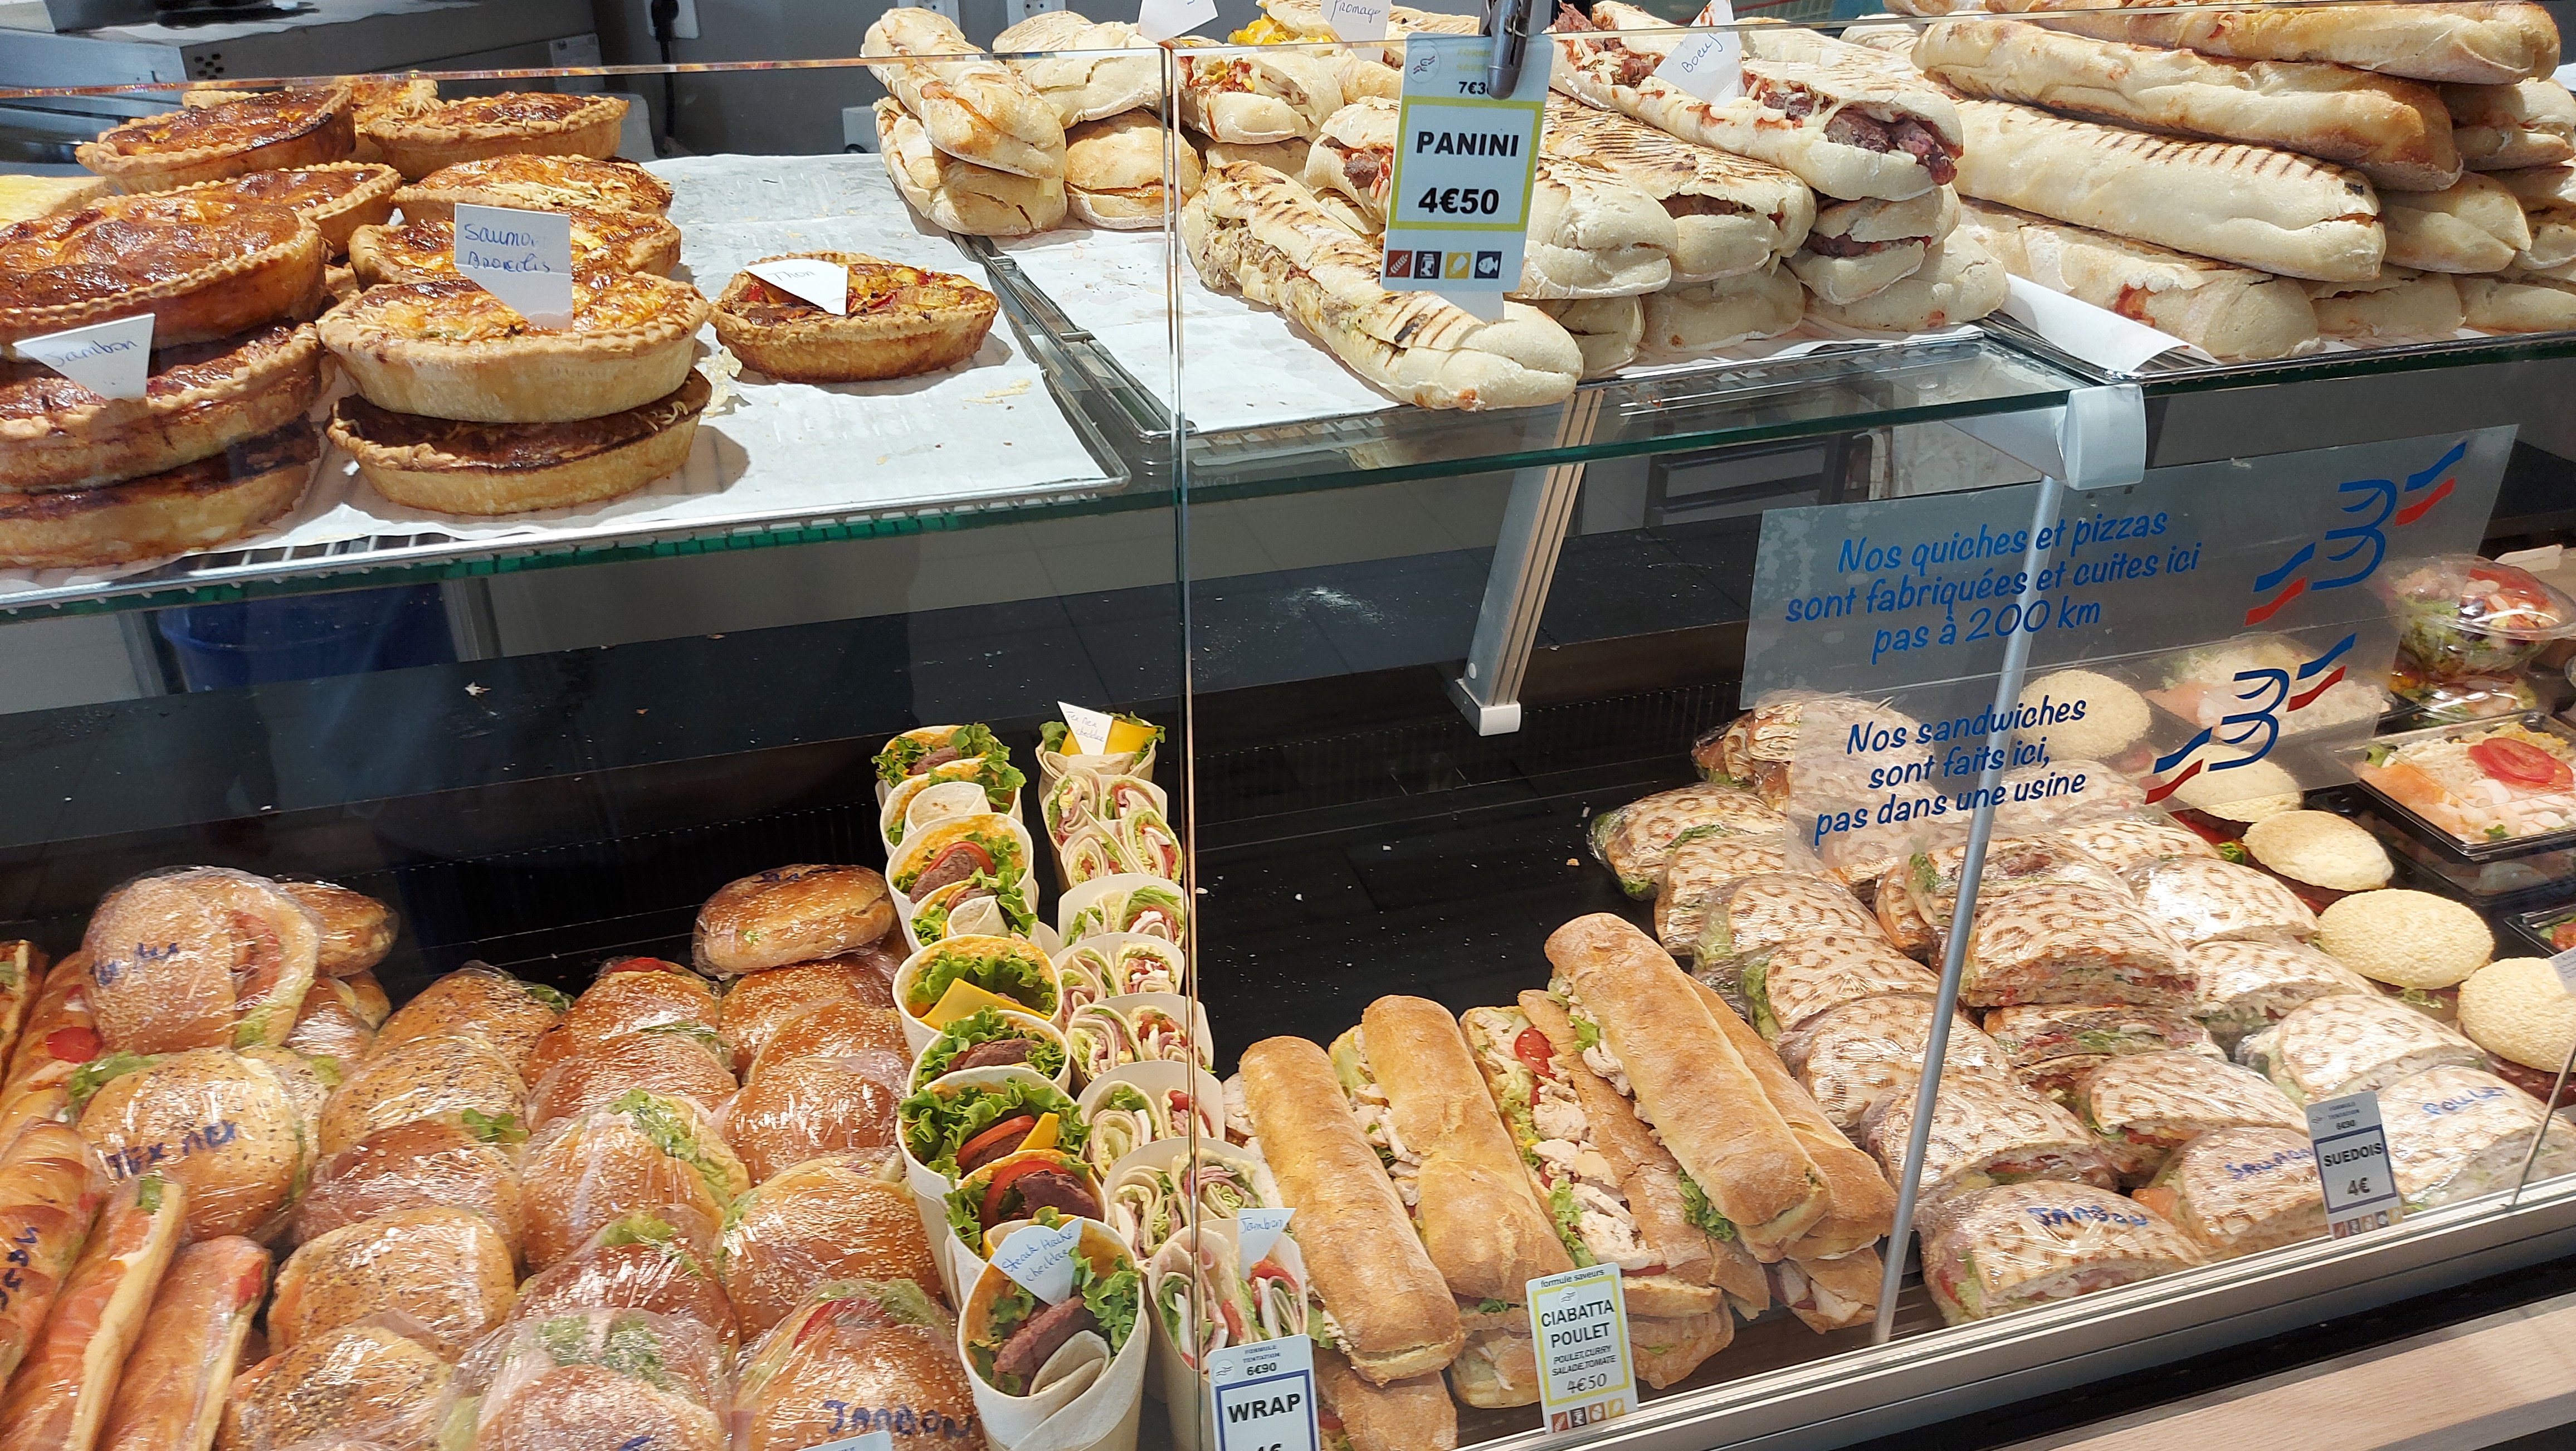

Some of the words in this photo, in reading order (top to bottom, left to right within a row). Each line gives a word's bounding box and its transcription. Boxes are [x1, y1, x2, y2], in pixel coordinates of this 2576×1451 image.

[1458, 81, 1489, 95] 7€3
[1417, 131, 1519, 157] PANINI
[1418, 187, 1499, 214] 4€50
[767, 271, 816, 281] Thon
[1838, 536, 1902, 573] Nos
[1911, 524, 2028, 577] quiches
[2035, 518, 2066, 551] et
[2070, 512, 2168, 557] pizzas
[1785, 587, 1857, 622] sont
[1866, 567, 2028, 616] fabriquées
[2036, 561, 2066, 591] et
[2073, 553, 2159, 586] cuites
[2166, 542, 2202, 574] ici
[1871, 625, 1930, 665] pas
[1938, 616, 1957, 646] à
[1965, 599, 2051, 642] 200
[2057, 596, 2101, 629] km
[1847, 721, 1907, 755] Nos
[1915, 695, 2087, 745] sandwiches
[1868, 755, 1934, 789] sont
[1943, 746, 2006, 777] faits
[2012, 737, 2050, 768] ici,
[1814, 807, 1868, 846] pas
[1877, 793, 1947, 825] dans
[1956, 787, 2006, 811] une
[2014, 771, 2086, 801] usine
[2323, 1142, 2383, 1167] SUEDOIS
[2347, 1176, 2371, 1196] 4€
[1540, 1275, 1573, 1288] formule
[1574, 1269, 1606, 1281] saveurs
[1541, 1299, 1615, 1328] CIABATTA
[1550, 1322, 1611, 1349] POULET
[1246, 1362, 1278, 1376] 6€90
[1567, 1373, 1608, 1394] 4€50
[1227, 1393, 1301, 1424] WRAP
